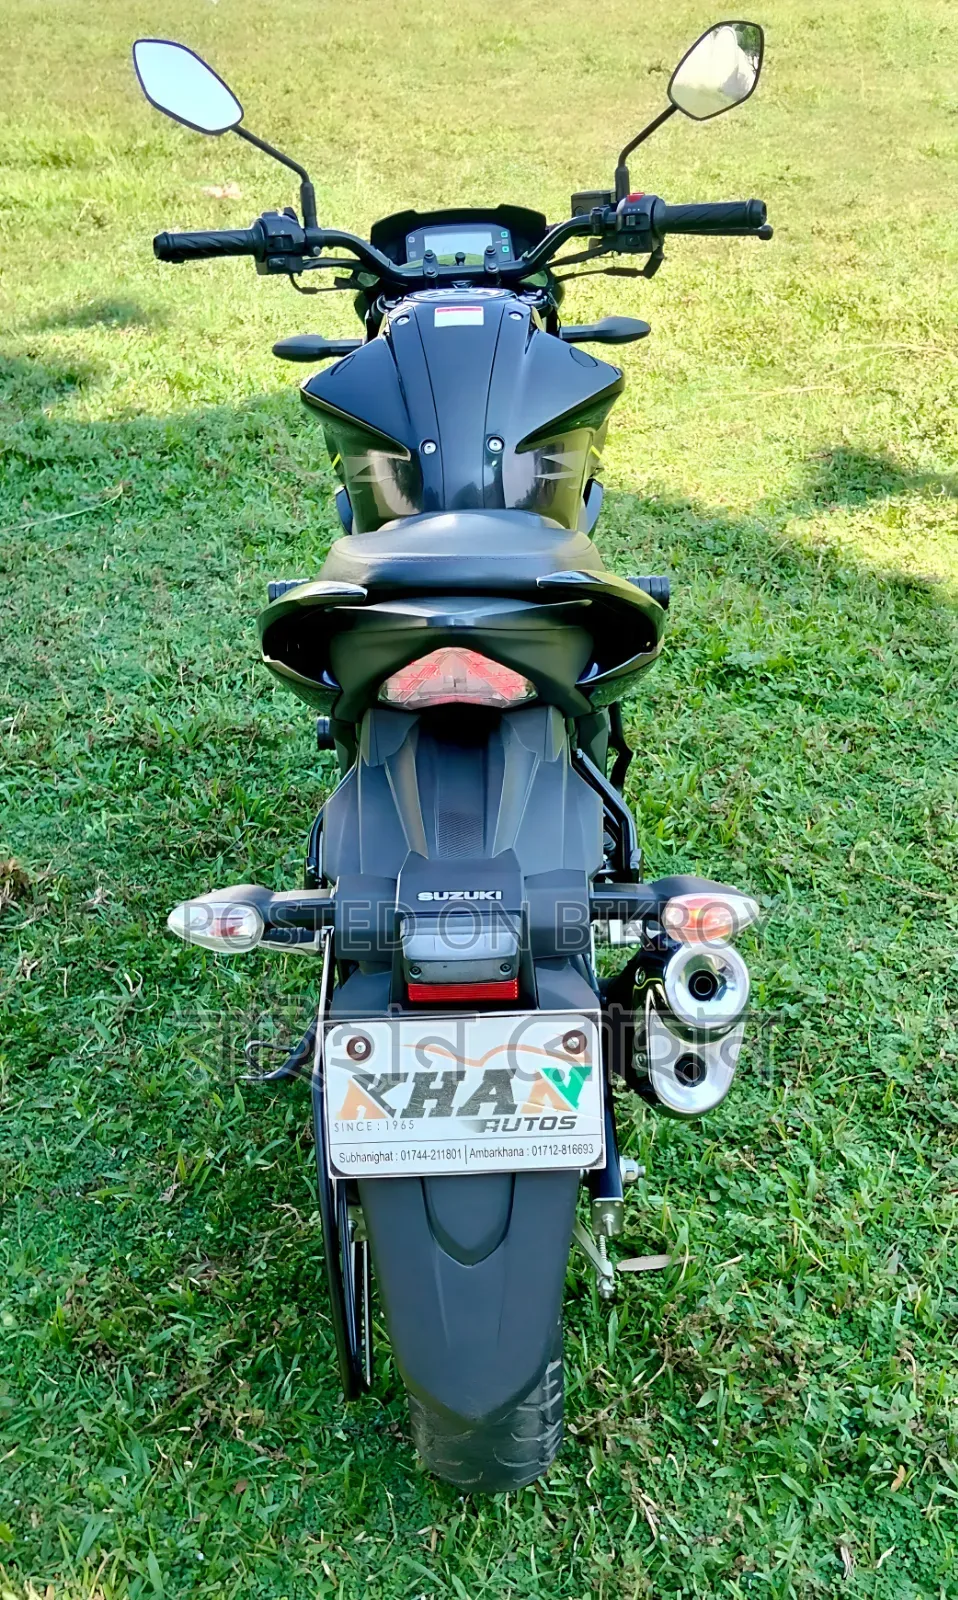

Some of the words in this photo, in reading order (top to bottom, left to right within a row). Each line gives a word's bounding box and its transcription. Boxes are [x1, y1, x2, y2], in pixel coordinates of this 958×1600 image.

[417, 890, 502, 901] SUZUKI
[335, 1066, 593, 1121] KHAN
[334, 1122, 373, 1133] SINCE
[385, 1120, 415, 1132] 1965
[481, 1115, 578, 1133] AUTOS
[338, 1150, 394, 1165] Subhanighat
[400, 1148, 462, 1161] 01744-211801
[469, 1147, 524, 1160] Ambarkhana
[532, 1143, 594, 1156] 01712-816693
